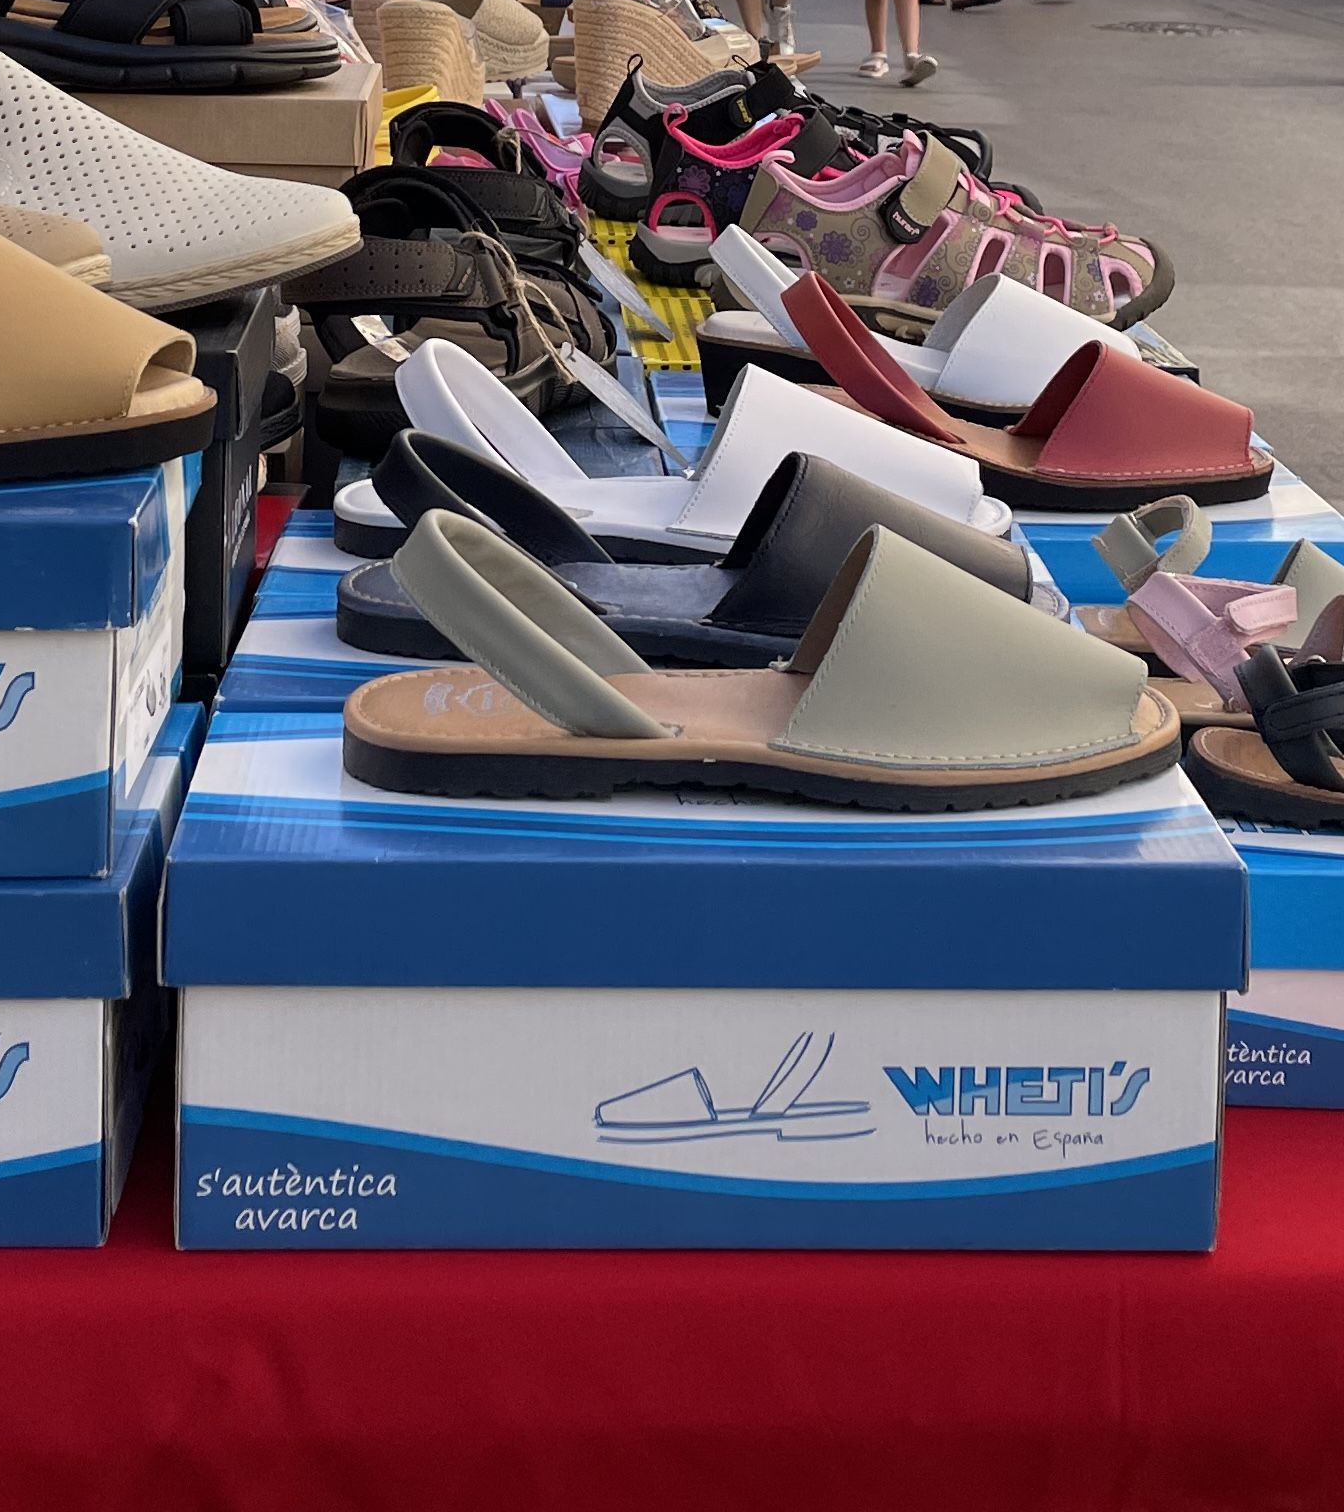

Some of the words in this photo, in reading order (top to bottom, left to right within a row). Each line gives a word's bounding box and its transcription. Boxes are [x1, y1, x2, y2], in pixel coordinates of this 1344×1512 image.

[1227, 1040, 1312, 1065] tèntica
[882, 1060, 1151, 1117] WHETI'S
[924, 1118, 983, 1147] hecho
[996, 1132, 1019, 1145] en
[1033, 1128, 1104, 1159] España
[196, 1162, 398, 1197] s'autèntica
[234, 1206, 359, 1231] avarca
